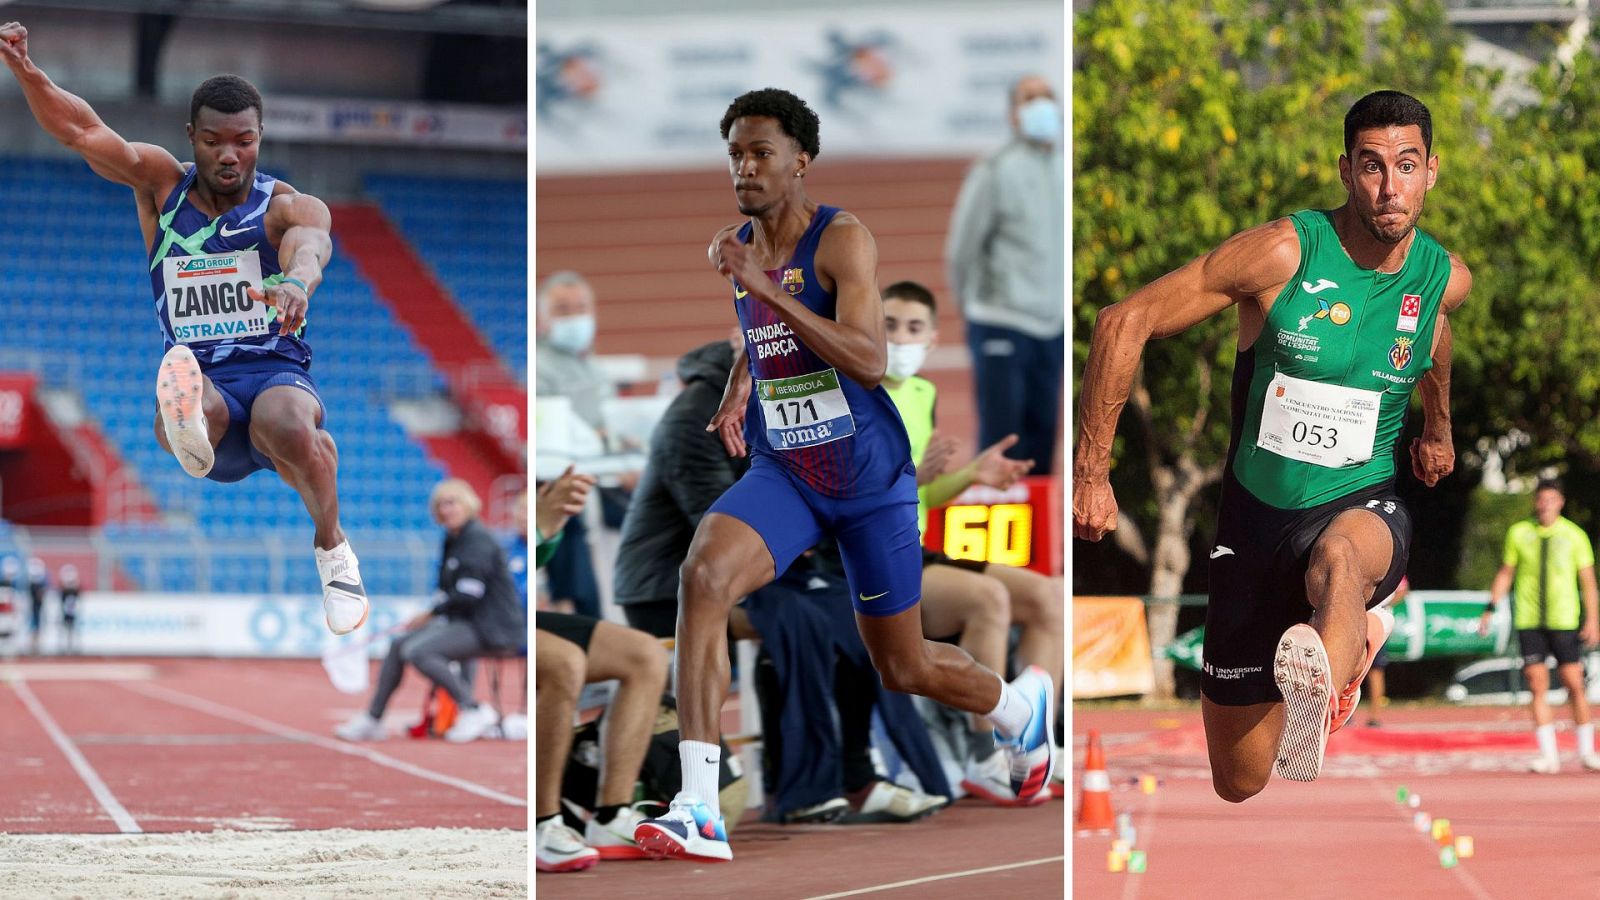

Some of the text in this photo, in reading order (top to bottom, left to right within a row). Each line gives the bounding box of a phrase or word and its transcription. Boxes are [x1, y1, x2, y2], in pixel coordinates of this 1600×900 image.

[192, 258, 235, 269] SD GROUP
[172, 280, 254, 318] ZANGO
[1277, 332, 1319, 346] COMUNITAT
[1278, 338, 1288, 346] DE
[757, 338, 799, 360] BARÇA
[1371, 370, 1407, 383] VILLARREAL
[776, 380, 825, 395] IBERDROLA
[775, 399, 819, 426] 171
[1289, 399, 1330, 412] ENCUENTRO
[1331, 407, 1363, 417] NACIONAL
[1292, 421, 1338, 449] 053
[944, 504, 1032, 567] 60
[1215, 666, 1263, 674] UNIVERSITAT
